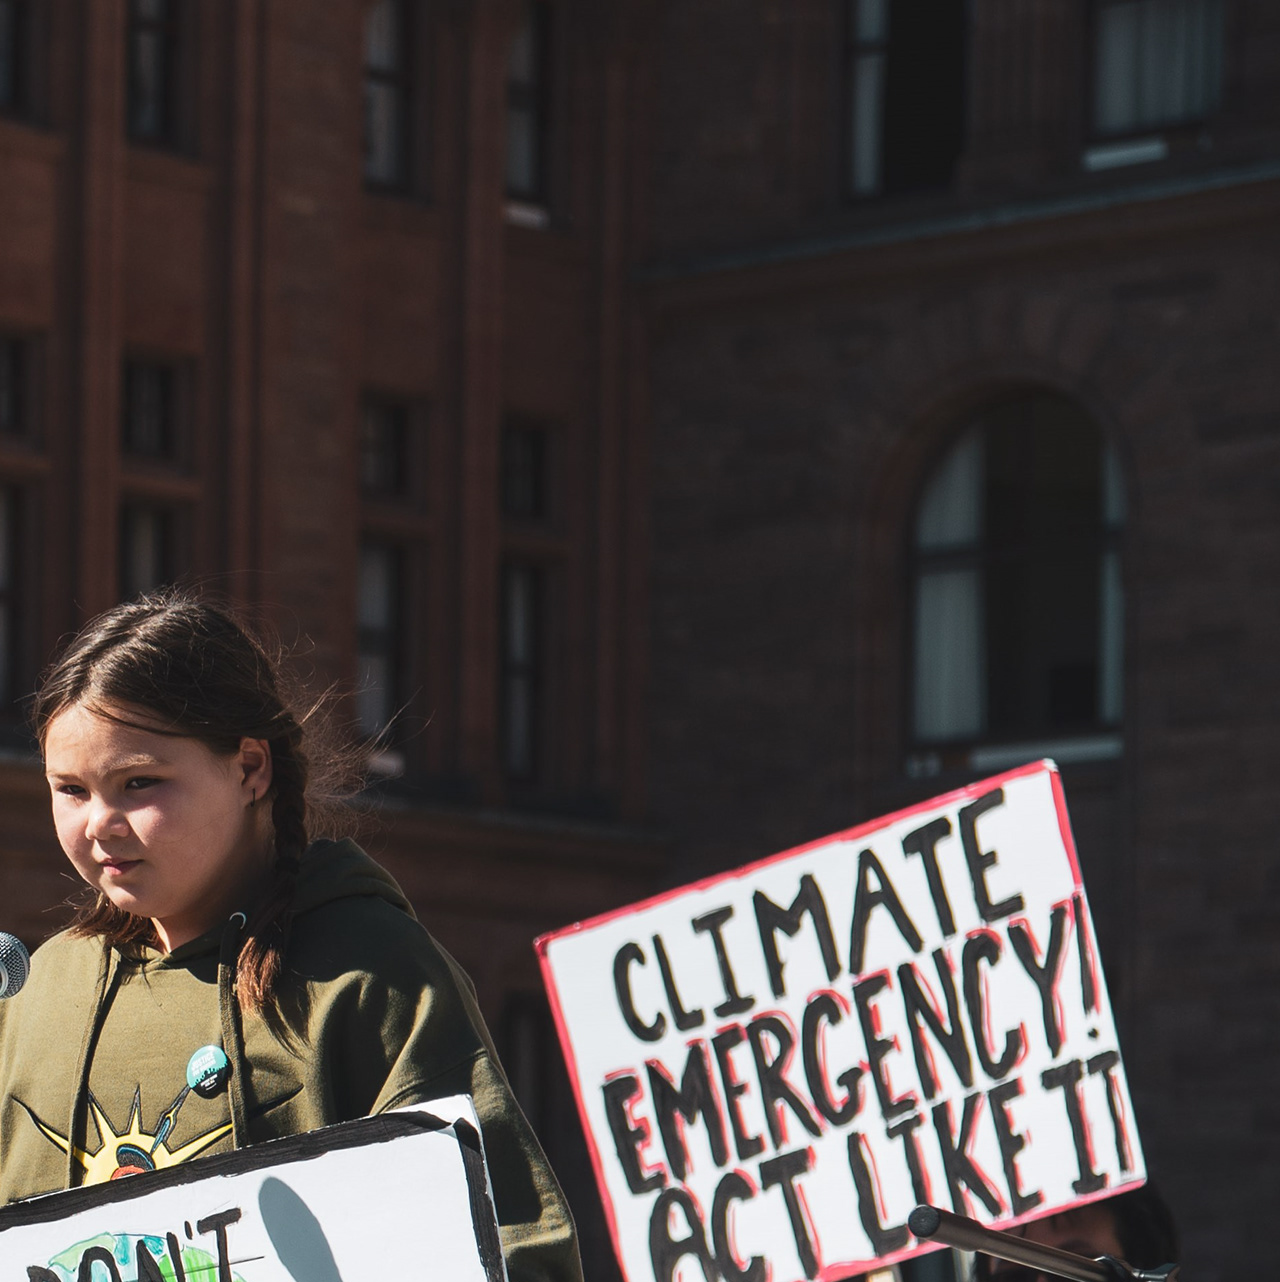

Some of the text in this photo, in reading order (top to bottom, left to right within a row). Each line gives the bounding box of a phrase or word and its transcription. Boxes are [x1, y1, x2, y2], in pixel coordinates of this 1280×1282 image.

[613, 787, 1024, 1042] CLIMATE
[602, 892, 1100, 1196] EMERGENCY!
[848, 1078, 1042, 1258] LIKE
